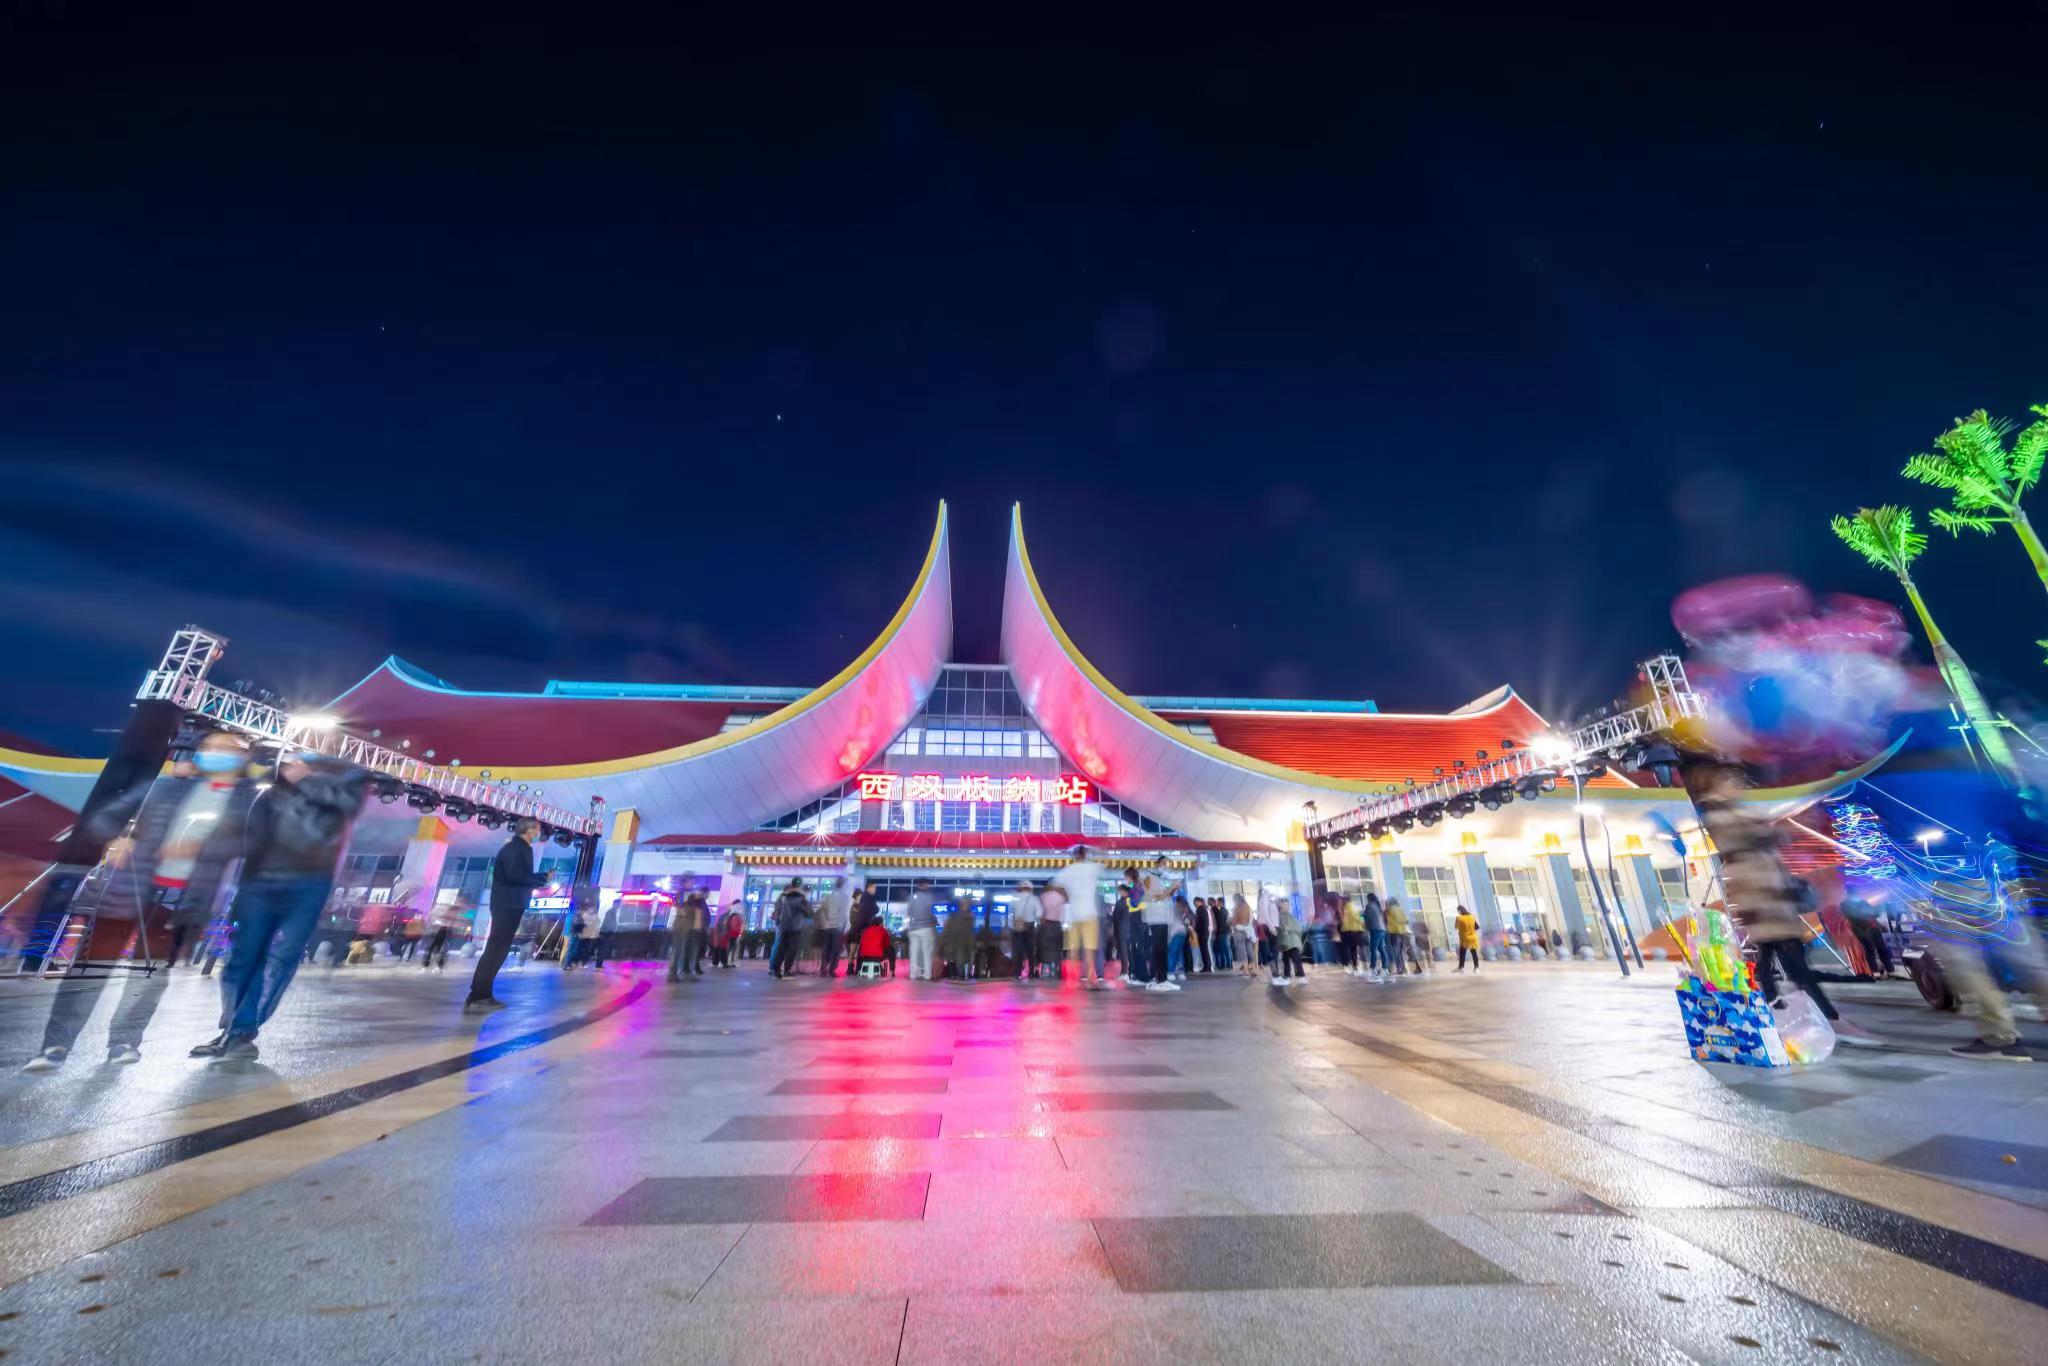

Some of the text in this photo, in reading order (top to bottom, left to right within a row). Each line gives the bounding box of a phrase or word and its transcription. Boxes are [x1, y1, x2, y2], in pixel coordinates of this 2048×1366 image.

[857, 773, 1088, 804] 西双版纳站
